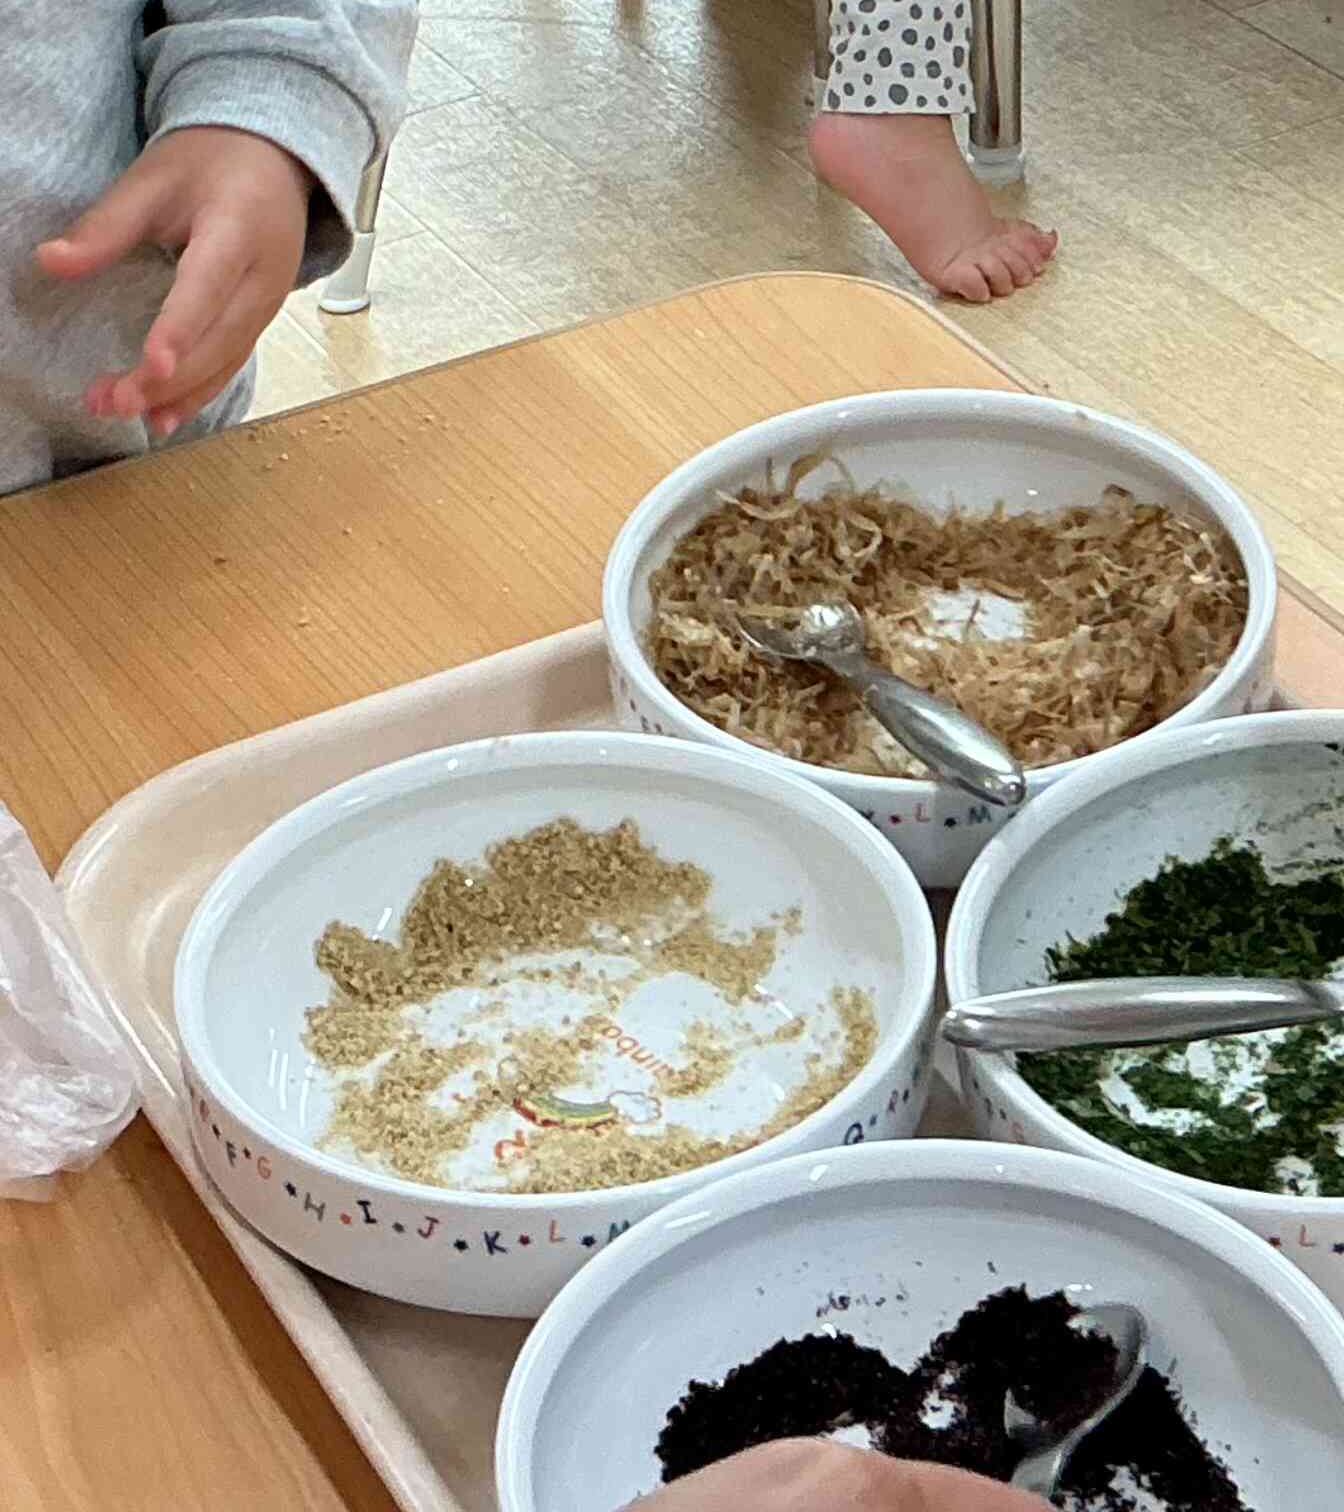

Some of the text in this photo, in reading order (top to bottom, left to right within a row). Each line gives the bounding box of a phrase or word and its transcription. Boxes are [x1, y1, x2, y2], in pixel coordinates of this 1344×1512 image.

[914, 803, 993, 824] L M
[257, 1156, 273, 1180] G
[304, 1192, 326, 1222] H
[356, 1200, 378, 1224] I
[417, 1215, 440, 1239] J
[483, 1230, 507, 1255] K
[548, 1218, 566, 1244] L
[1298, 1223, 1316, 1248] L
